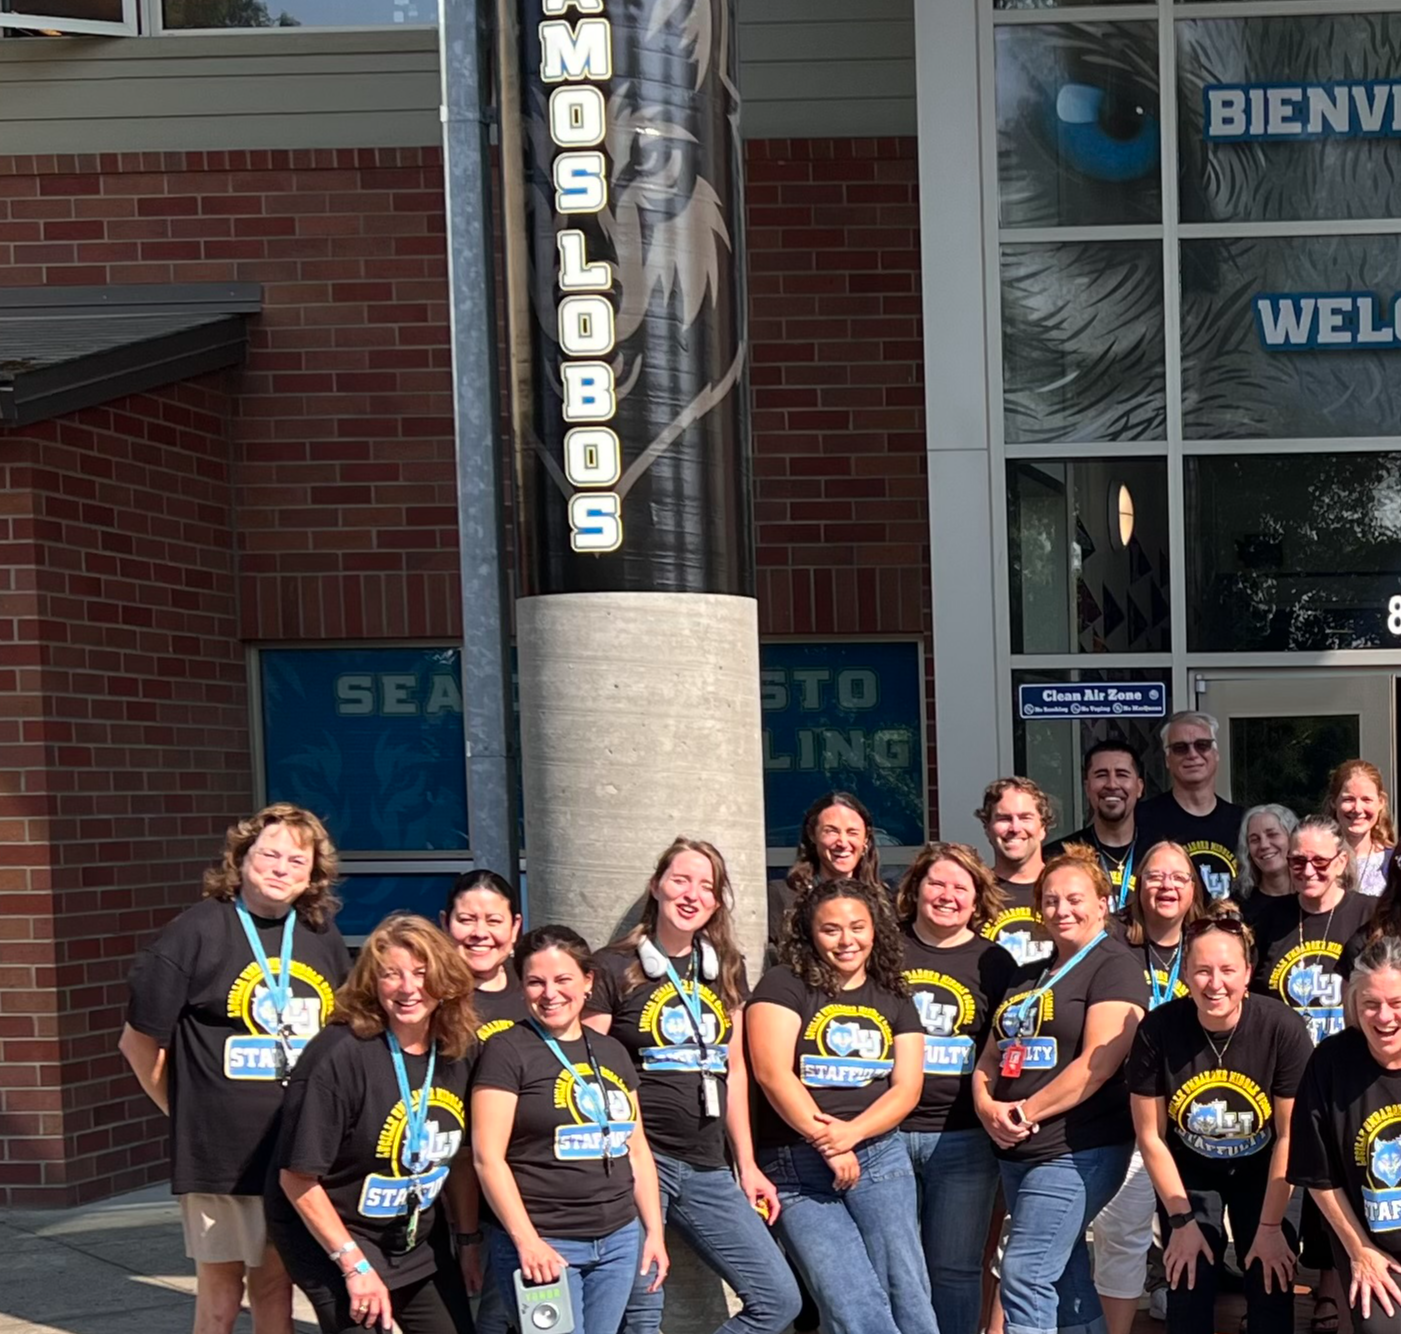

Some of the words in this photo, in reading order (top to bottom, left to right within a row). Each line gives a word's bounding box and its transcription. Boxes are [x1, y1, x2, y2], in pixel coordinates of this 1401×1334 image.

[539, 0, 612, 214] MOS
[556, 229, 623, 553] LOBOS
[761, 670, 877, 709] STO
[1042, 690, 1081, 702] Clean
[1083, 689, 1106, 701] Air
[1107, 689, 1142, 701] Zone
[763, 729, 911, 768] LING
